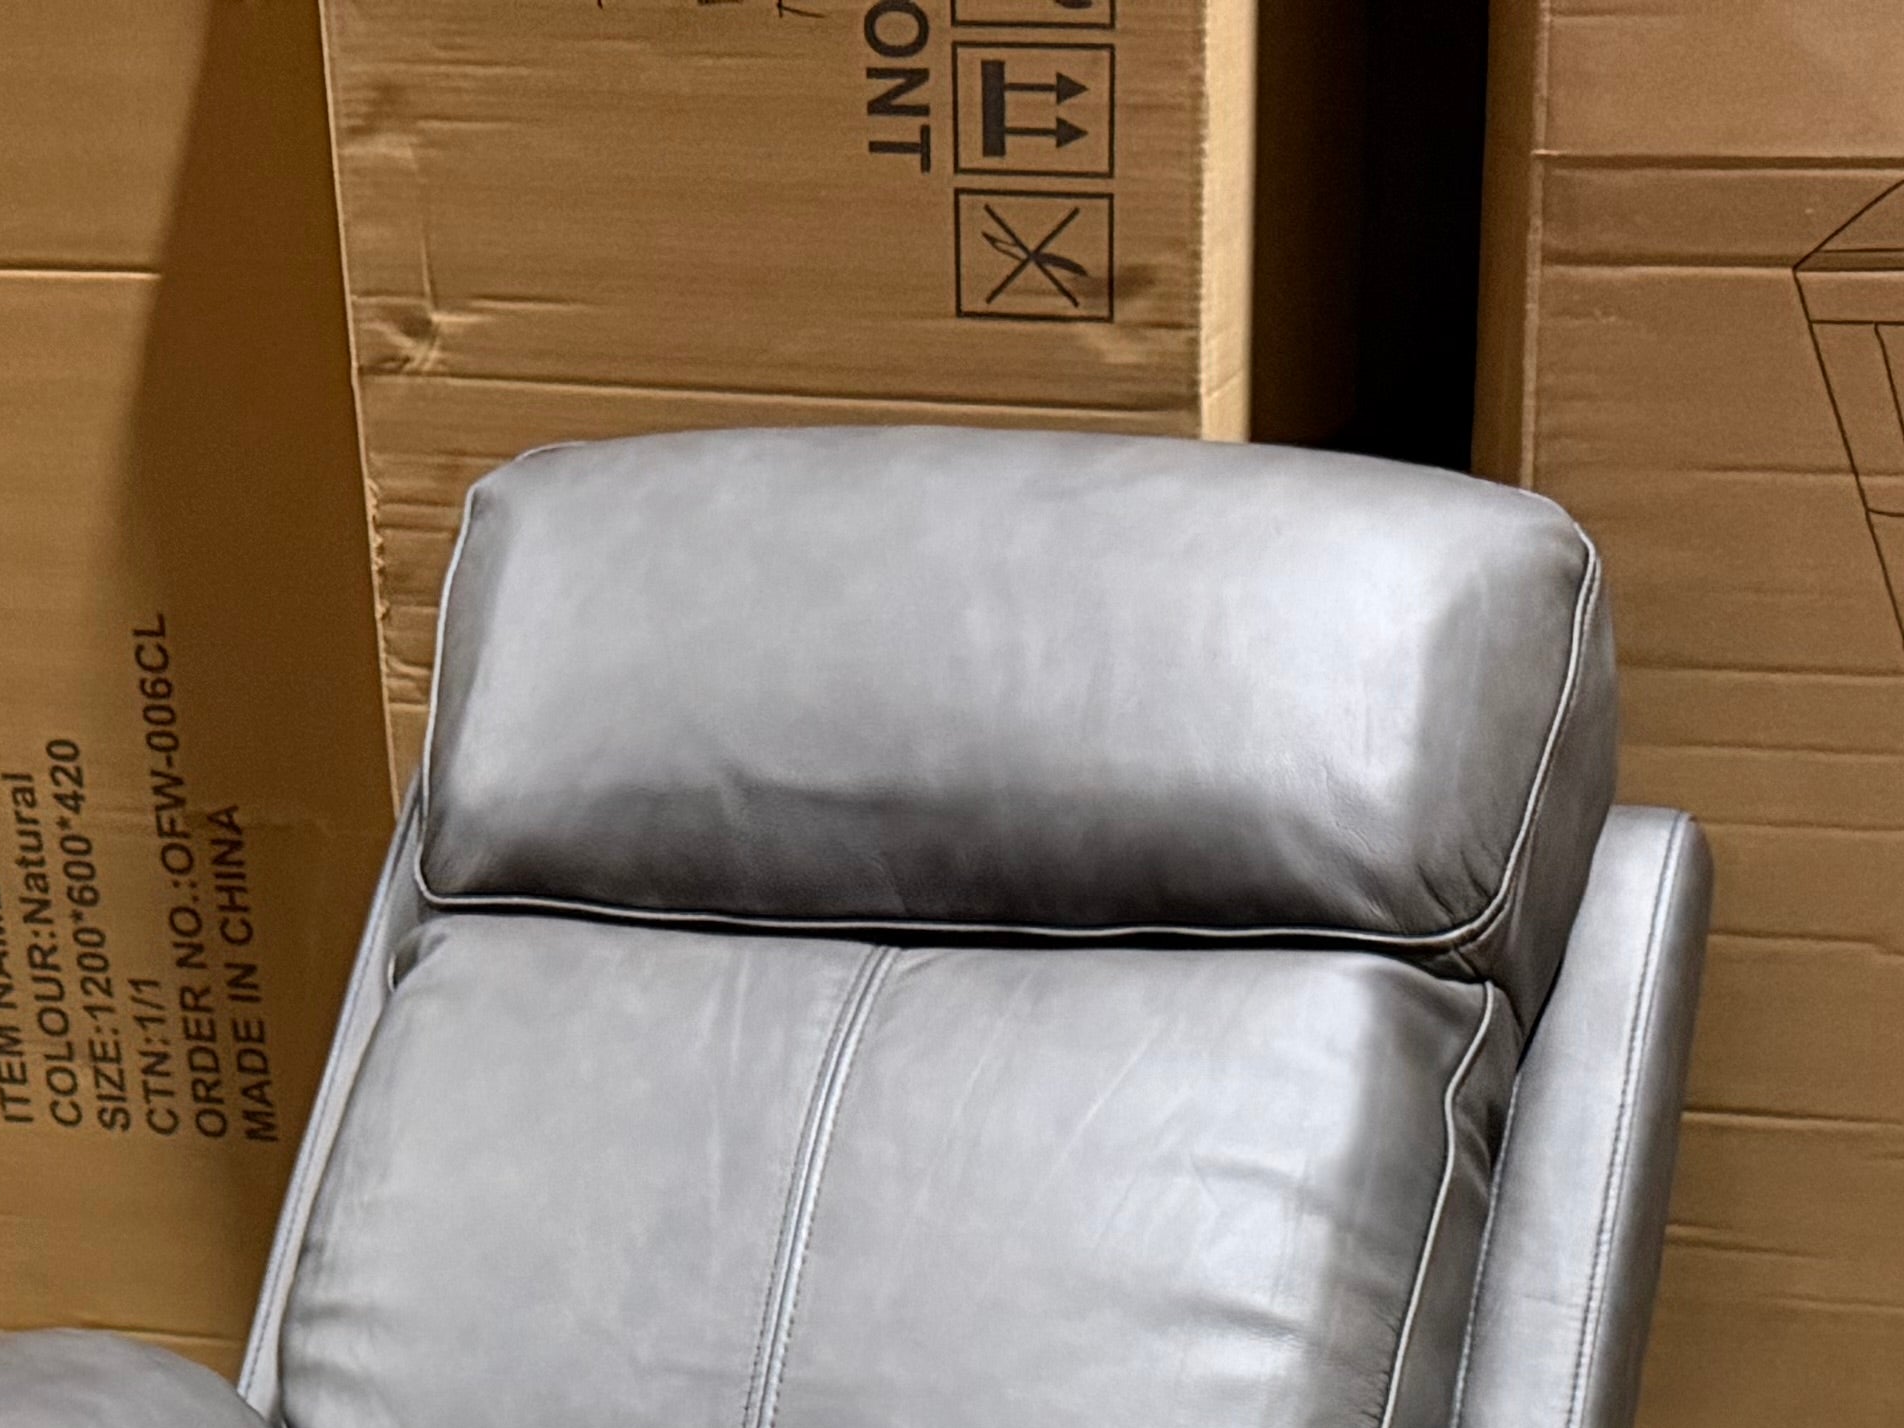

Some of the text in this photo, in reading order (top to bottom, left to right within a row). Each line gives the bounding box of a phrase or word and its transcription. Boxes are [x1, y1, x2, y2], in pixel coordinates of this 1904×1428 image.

[864, 0, 930, 173] ONT
[1, 773, 82, 1127] COLOUR:Natural
[133, 612, 228, 1138] ORDER NO.:OFW-006CL
[207, 804, 278, 1142] MADE IN CHINA
[127, 978, 179, 1135] CTN:1/1
